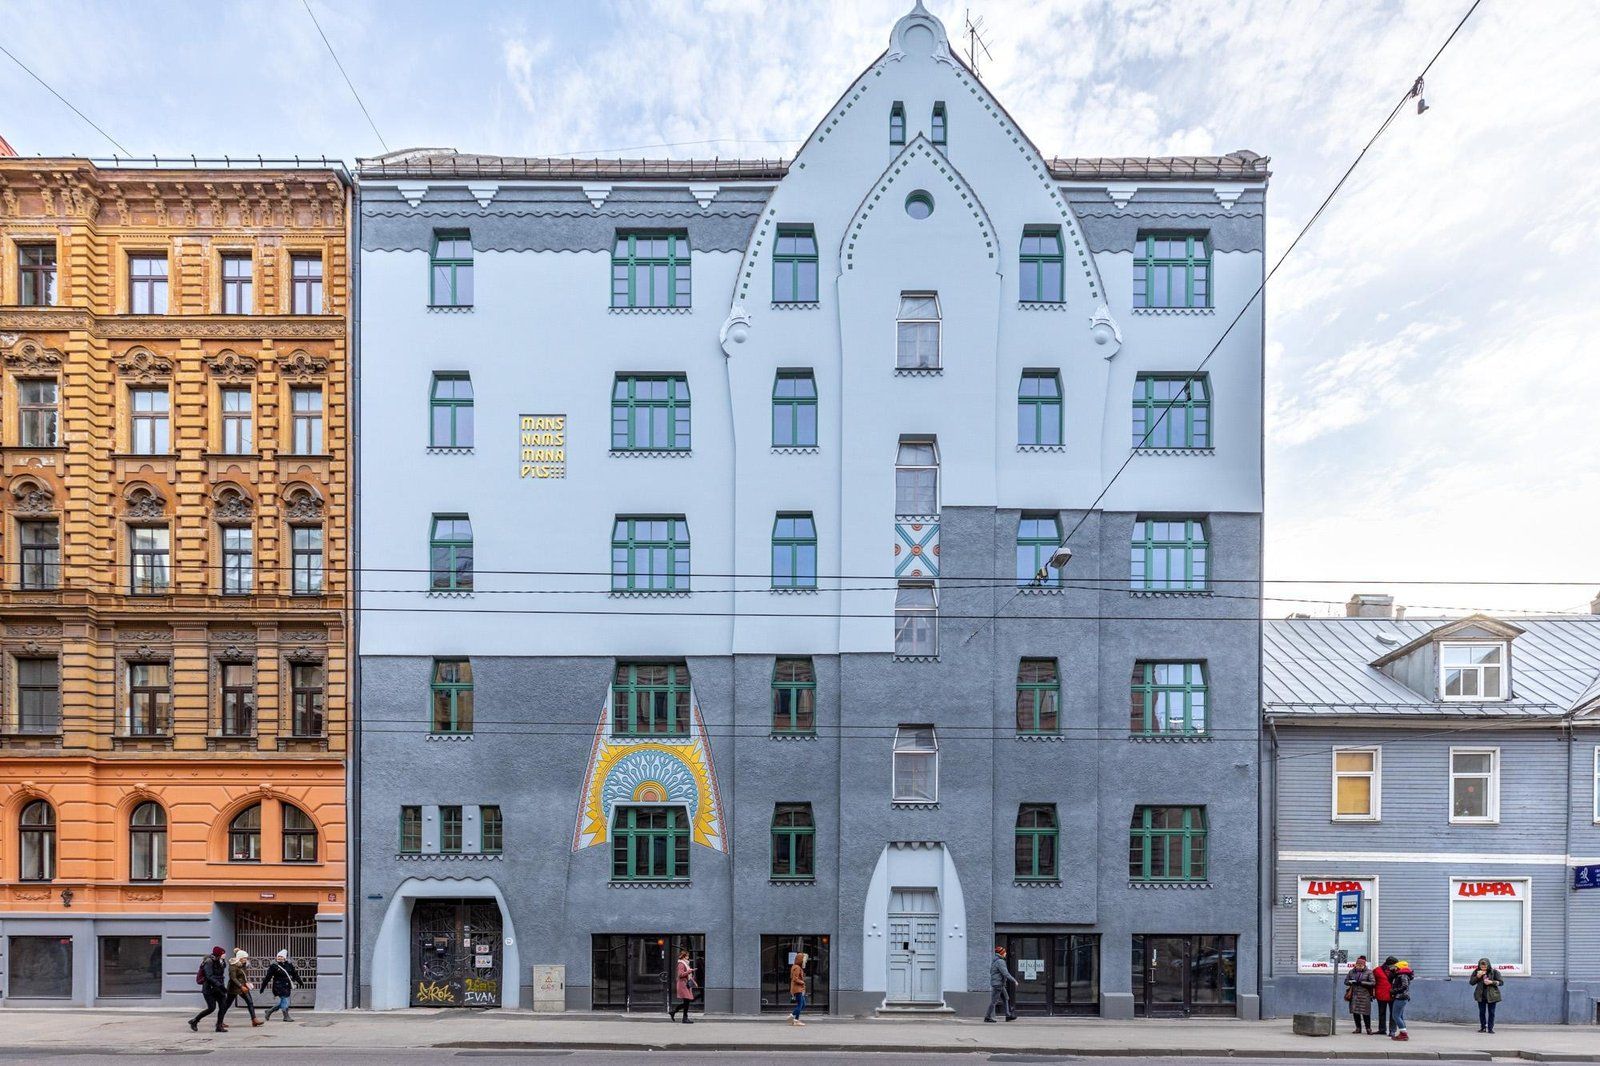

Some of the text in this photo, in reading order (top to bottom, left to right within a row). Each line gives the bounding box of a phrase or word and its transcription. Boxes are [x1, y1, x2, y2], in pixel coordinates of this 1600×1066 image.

[522, 417, 564, 430] MANS
[522, 433, 564, 446] NAMS
[522, 449, 564, 462] MANA
[1308, 882, 1362, 895] LUPPA
[1458, 882, 1515, 896] LUPPA
[465, 992, 496, 1003] IVAN
